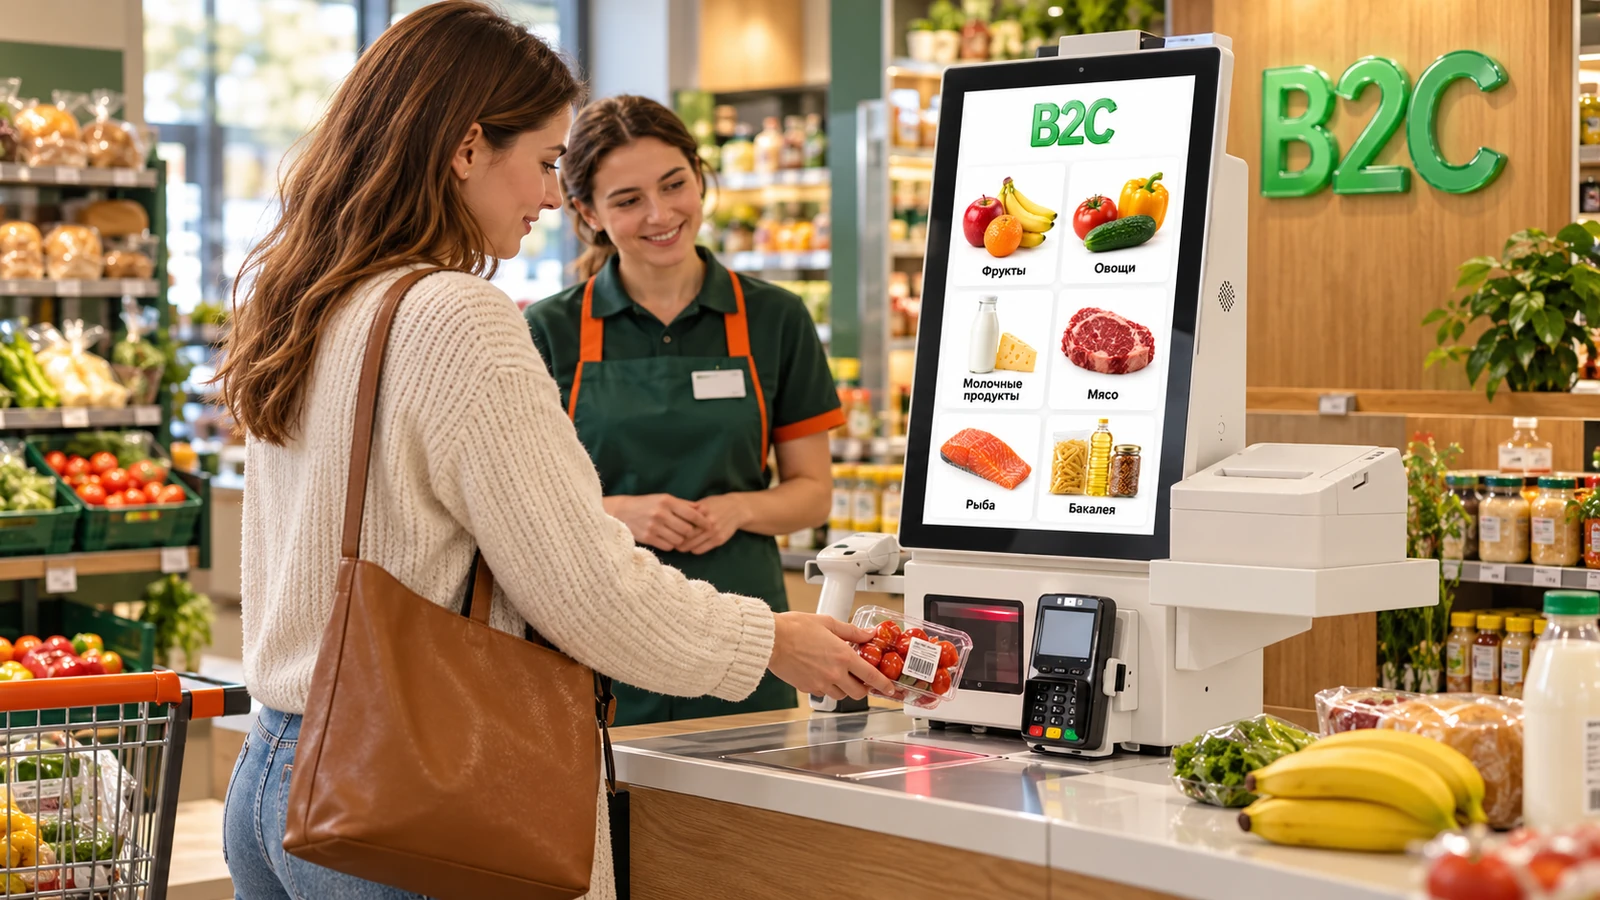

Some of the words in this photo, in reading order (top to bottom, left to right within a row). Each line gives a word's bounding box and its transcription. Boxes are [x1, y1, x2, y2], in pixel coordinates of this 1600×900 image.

[1030, 97, 1118, 148] B2C
[1261, 50, 1508, 198] B2C
[981, 265, 1027, 278] Фрукты
[1094, 262, 1136, 275] Овощи
[963, 378, 1023, 390] Молочные
[963, 391, 1020, 403] продукты
[1087, 388, 1119, 401] Мясо
[965, 498, 996, 511] Рыба
[1068, 502, 1116, 515] Бакалея
